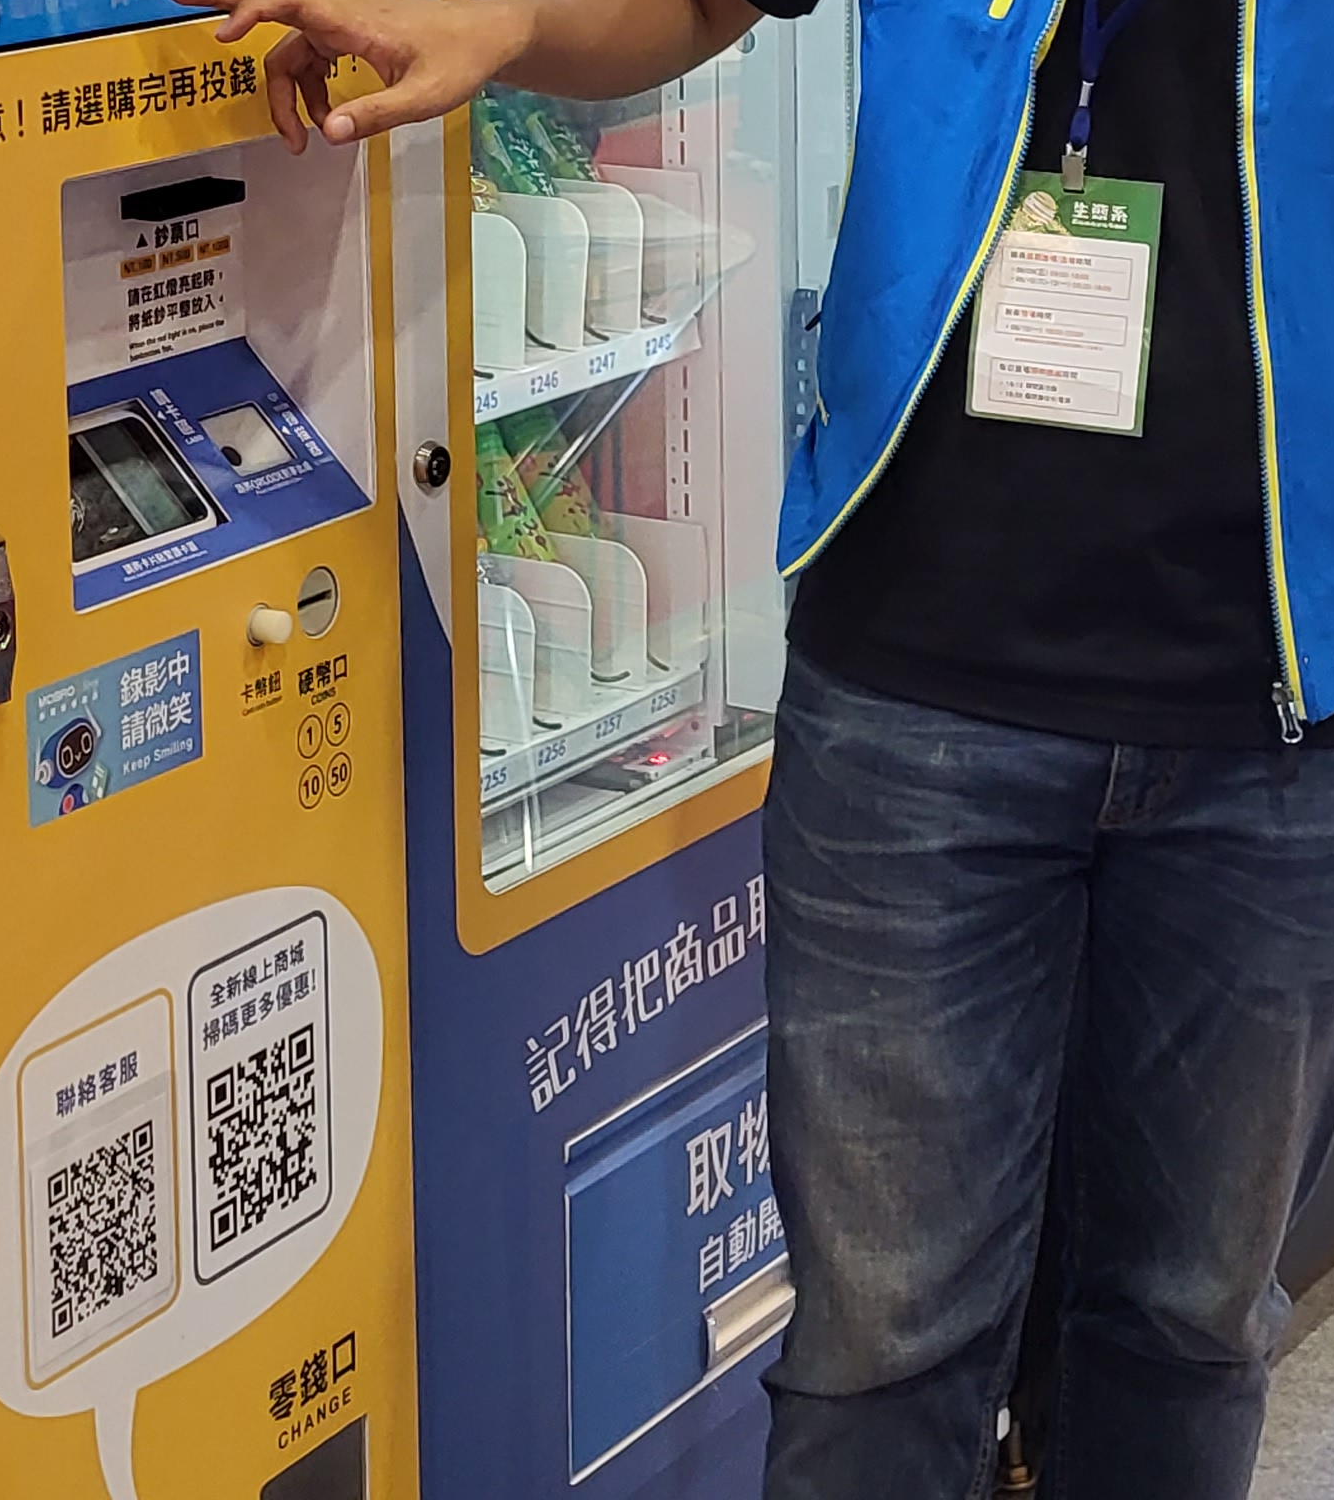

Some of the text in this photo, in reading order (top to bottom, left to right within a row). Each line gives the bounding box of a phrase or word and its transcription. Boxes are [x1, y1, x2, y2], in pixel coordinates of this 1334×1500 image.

[536, 371, 559, 394] 246
[595, 352, 616, 374] 247
[476, 391, 499, 414] 245
[120, 650, 190, 708] 錄影中
[298, 654, 349, 698] 硬幣口
[121, 692, 193, 752] 請微笑
[123, 737, 194, 776] Keep Smiling
[483, 767, 508, 793] 255
[210, 940, 305, 1009] 全新線上商城
[56, 1051, 140, 1118] 聯絡客服
[269, 1330, 356, 1421] 零錢口
[278, 1386, 352, 1450] CHANGE
